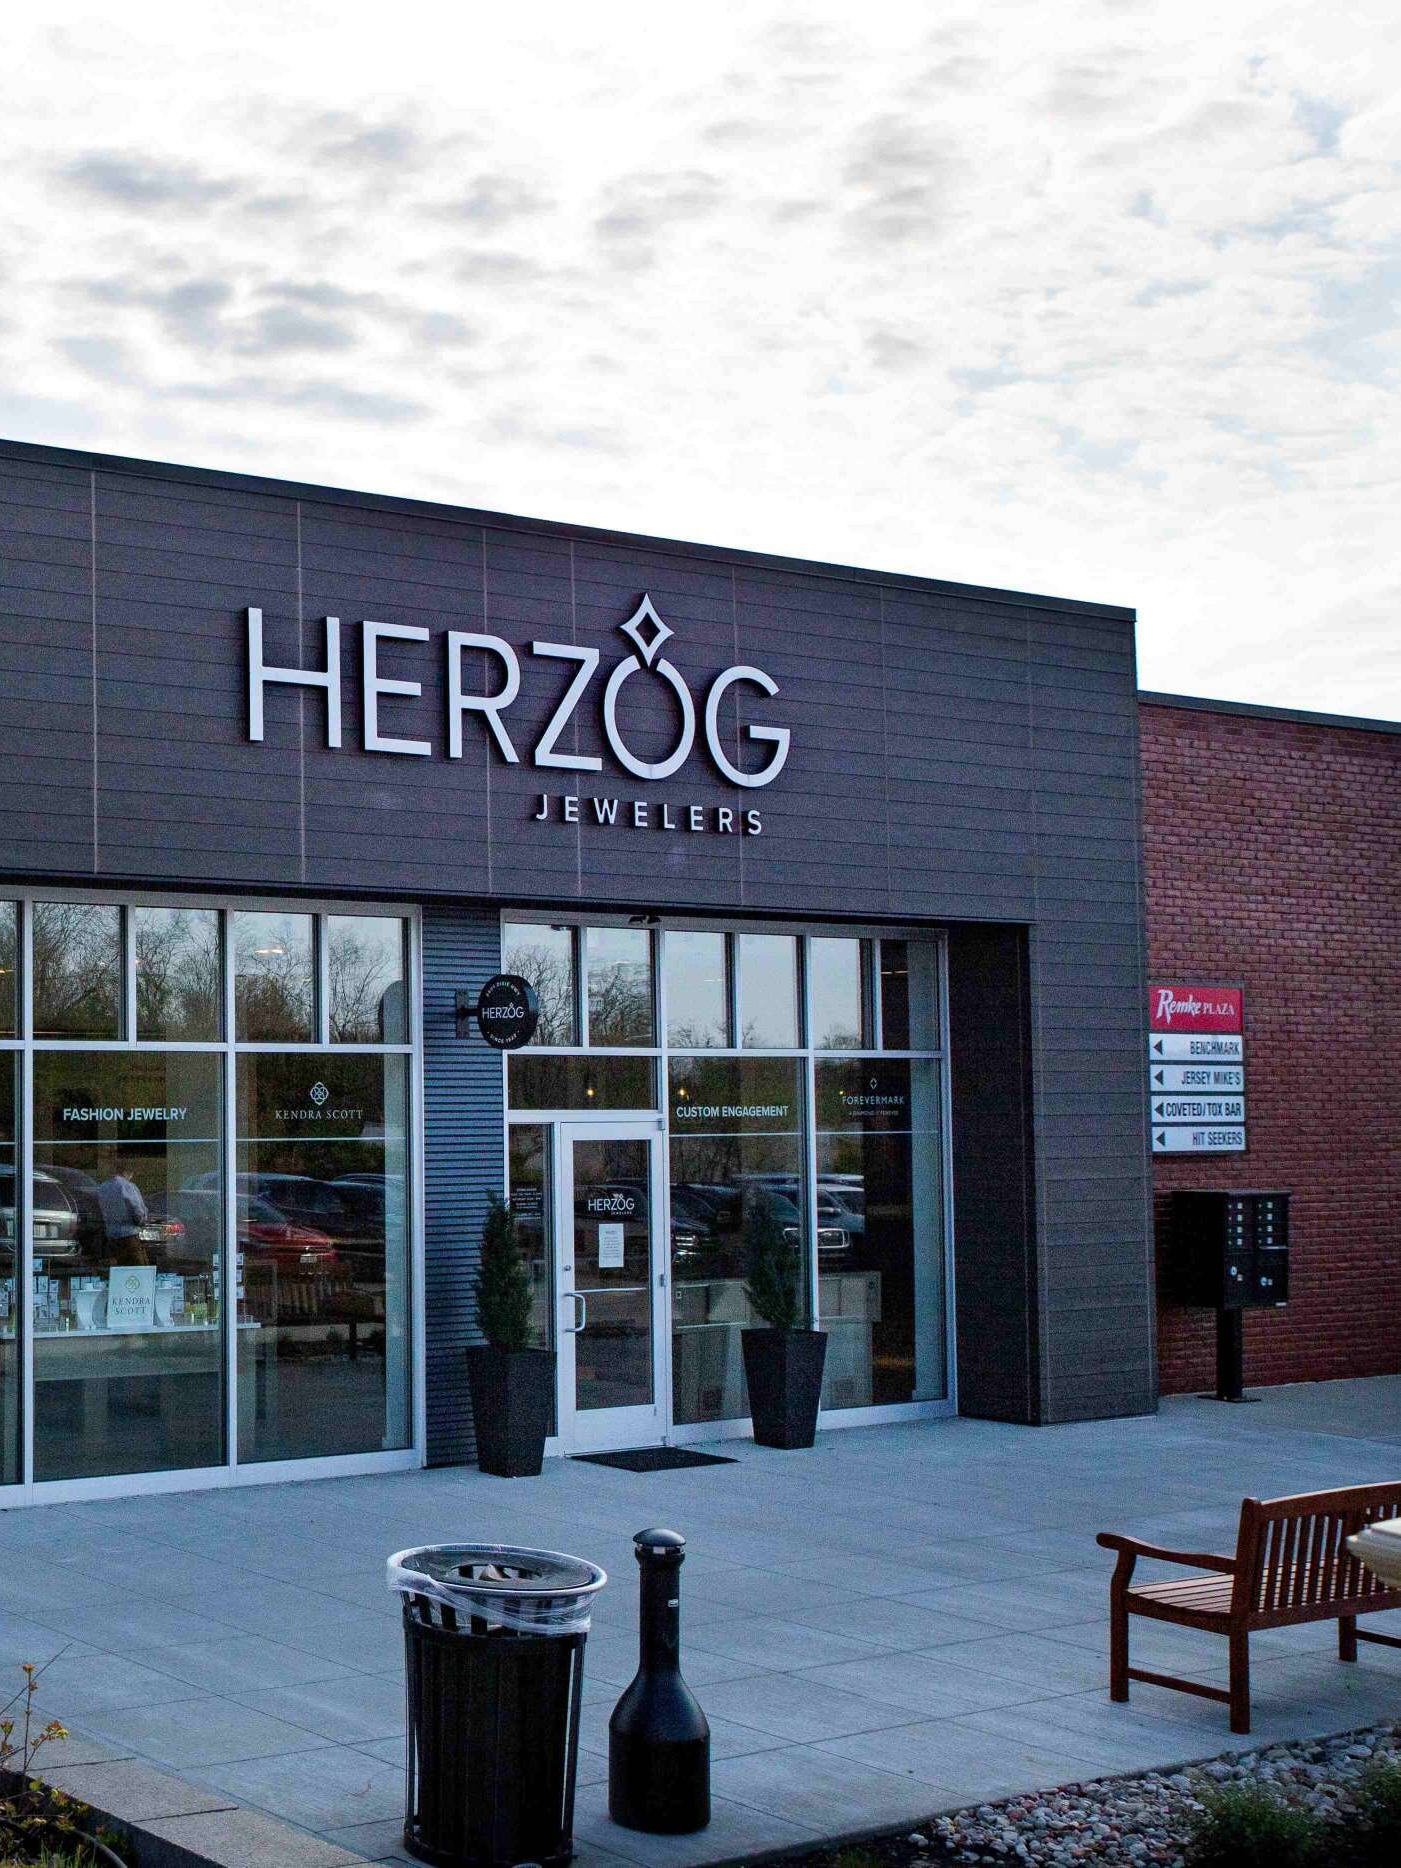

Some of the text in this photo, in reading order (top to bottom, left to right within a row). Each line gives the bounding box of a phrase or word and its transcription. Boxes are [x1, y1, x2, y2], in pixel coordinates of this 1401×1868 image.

[247, 594, 790, 788] HERZOG
[536, 794, 763, 836] JEWELERS
[482, 1003, 525, 1019] HERZOG
[1156, 989, 1235, 1024] Remke PLAZA
[1190, 1041, 1240, 1055] BENCHMARK
[1181, 1071, 1241, 1085] JERSEY MIKE'S
[842, 1094, 904, 1106] FOREVERMARK
[63, 1107, 187, 1121] FASHION JEWELRY
[275, 1108, 363, 1120] KENDRA SCOTT
[676, 1105, 789, 1117] CUSTOM ENGAGEMENT
[1225, 1102, 1241, 1116] BAR
[1193, 1131, 1242, 1145] HIT SEEKERS
[588, 1195, 635, 1211] HERZOG
[112, 1297, 151, 1308] KENDRA
[114, 1306, 146, 1316] SCOTT
